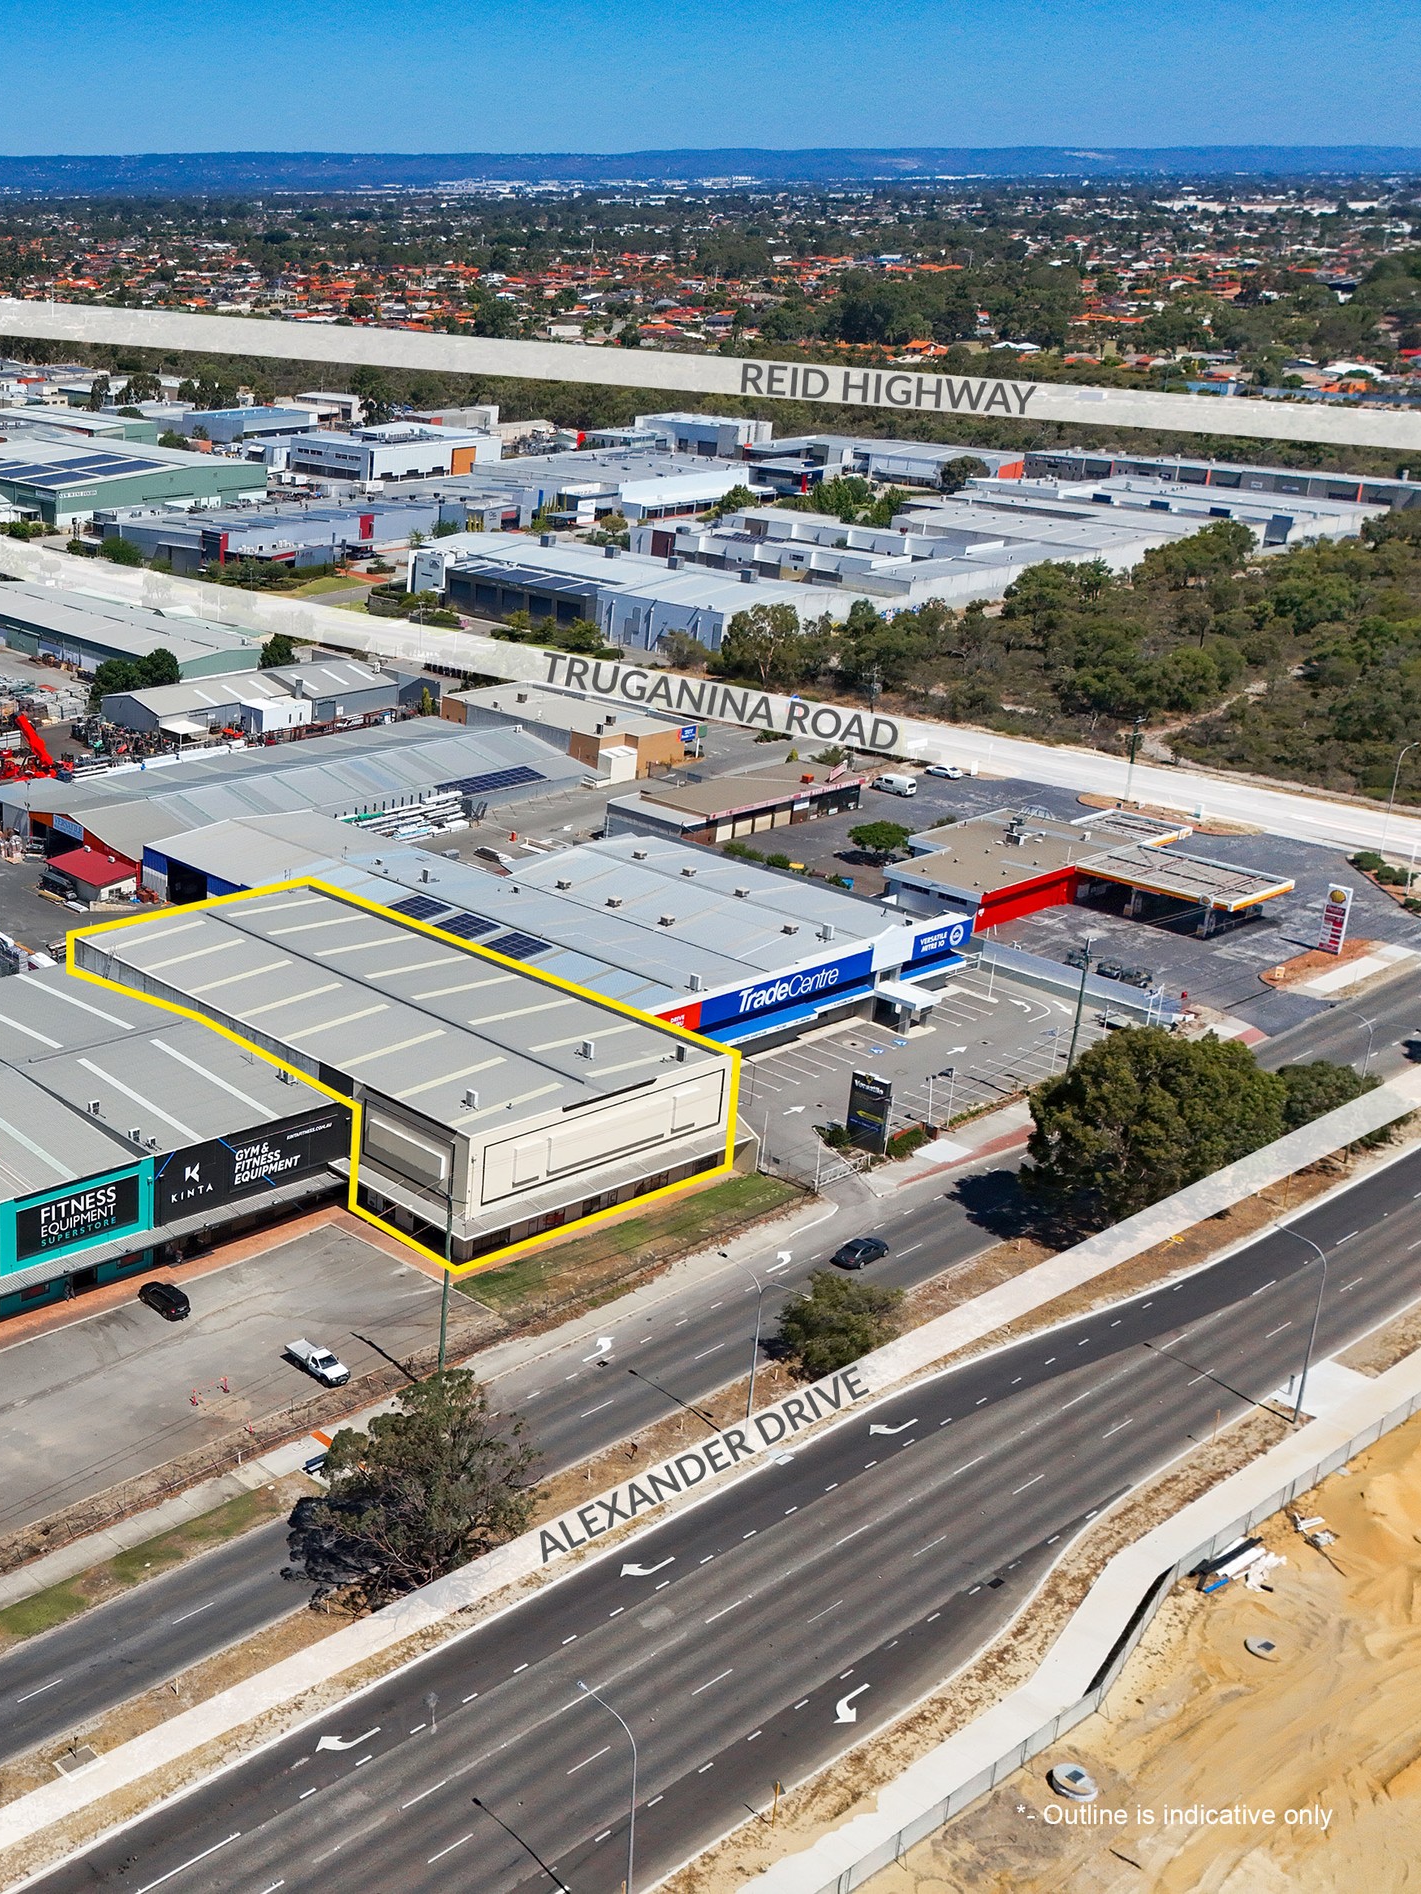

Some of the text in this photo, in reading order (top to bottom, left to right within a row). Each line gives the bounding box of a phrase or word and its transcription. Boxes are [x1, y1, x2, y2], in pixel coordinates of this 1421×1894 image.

[920, 931, 947, 946] VERSATILE
[739, 967, 839, 1013] TradeCentre
[234, 1150, 281, 1174] FITNESS
[235, 1141, 270, 1161] GYM &
[234, 1155, 301, 1186] EQUIPMENT
[40, 1186, 117, 1224] FITNESS
[171, 1183, 214, 1203] KINTA
[40, 1203, 117, 1238] EQUIPMENT
[41, 1216, 117, 1247] SUPERSTORE
